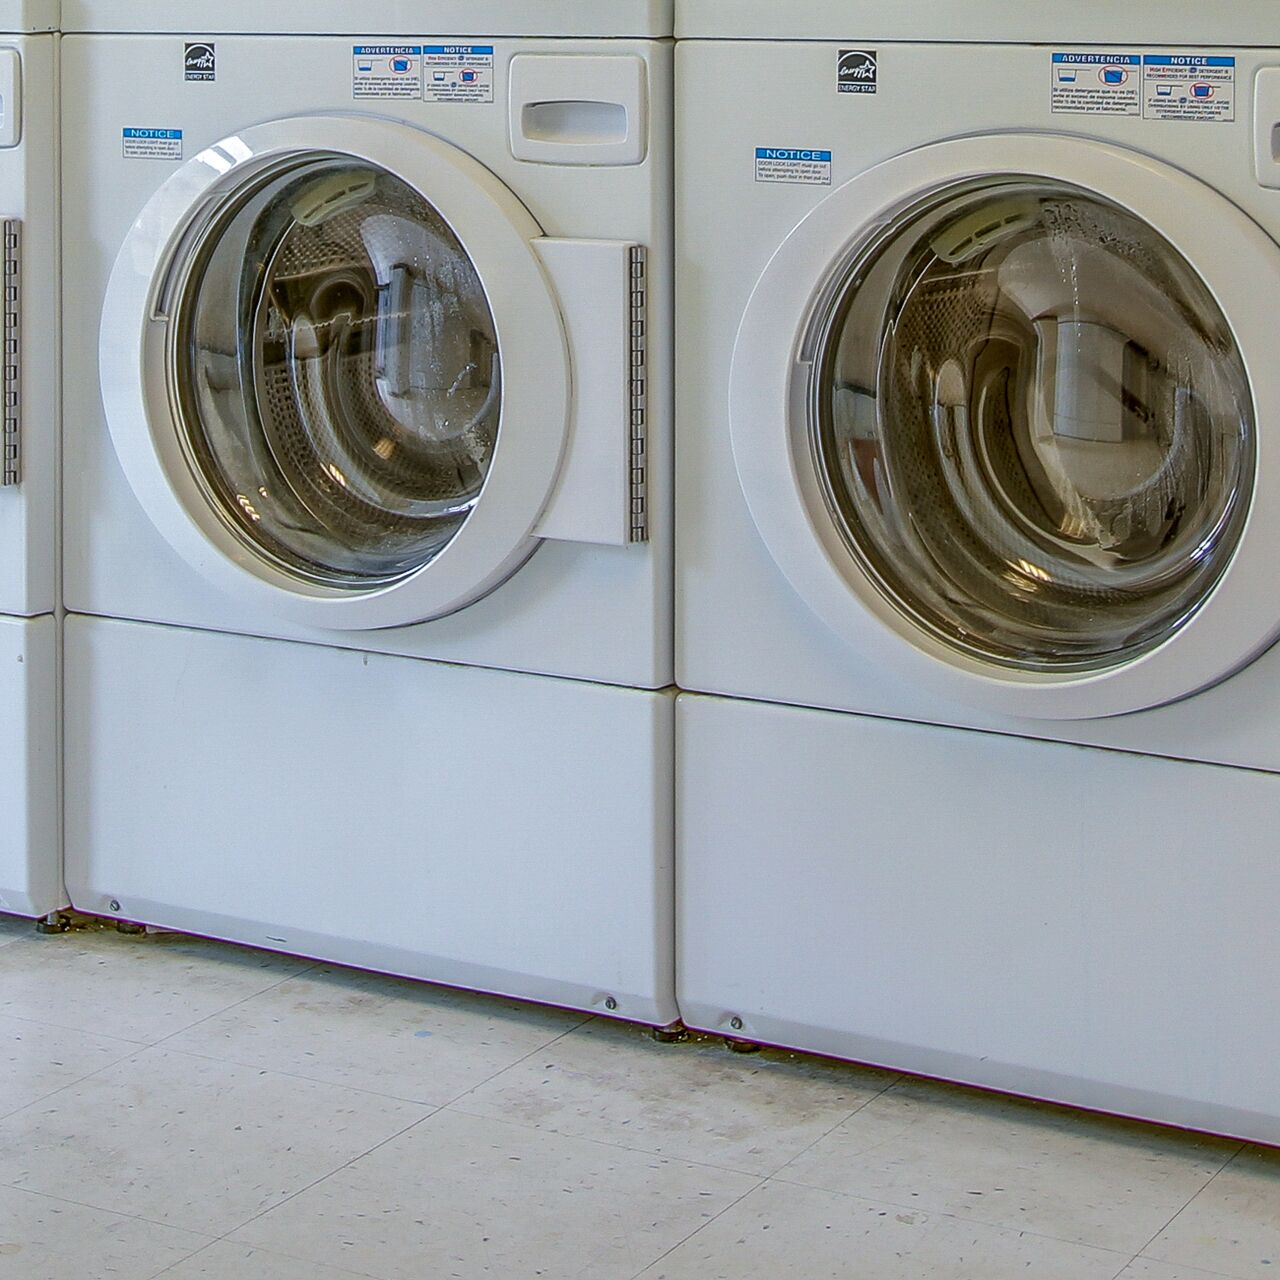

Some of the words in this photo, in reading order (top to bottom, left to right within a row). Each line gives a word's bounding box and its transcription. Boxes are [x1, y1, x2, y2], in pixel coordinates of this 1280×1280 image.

[1062, 55, 1130, 63] ADVERTENCIA
[131, 129, 175, 138] NOTICE
[766, 150, 821, 160] NOTICE
